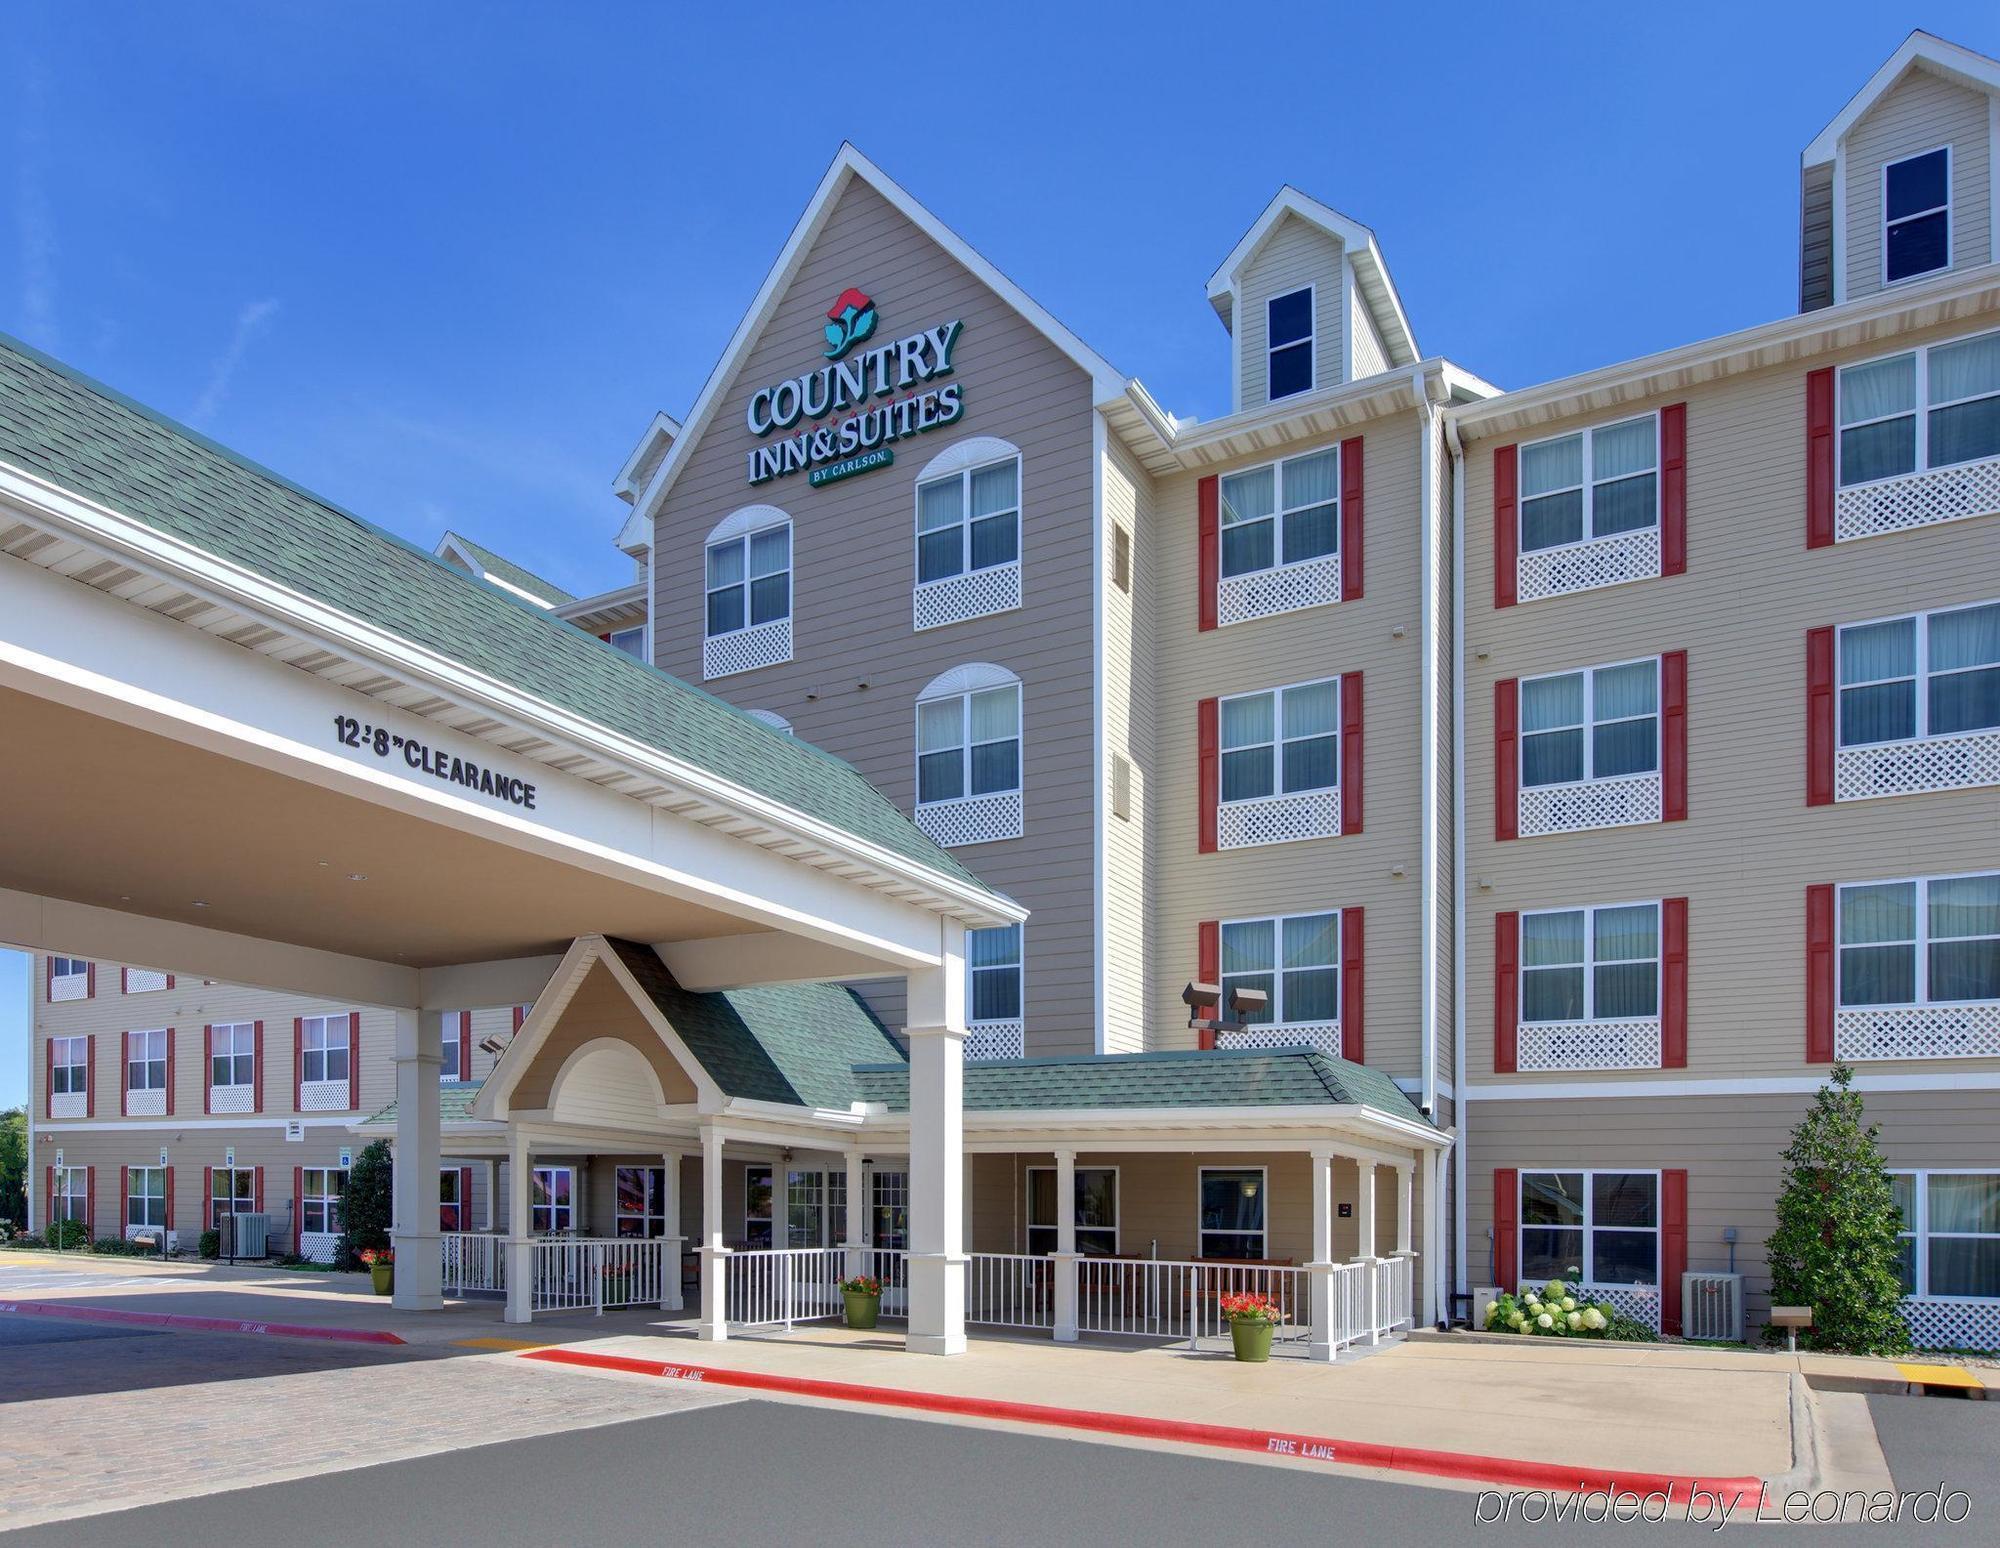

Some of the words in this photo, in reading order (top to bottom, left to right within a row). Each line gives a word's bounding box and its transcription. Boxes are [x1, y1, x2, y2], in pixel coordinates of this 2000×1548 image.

[748, 319, 964, 437] COUNTRY
[814, 469, 828, 482] BY
[832, 451, 886, 476] CARLSON
[661, 1366, 682, 1378] FIRE
[682, 1369, 705, 1381] LANE
[1267, 1438, 1297, 1454] FIRE
[1301, 1443, 1336, 1460] LANE
